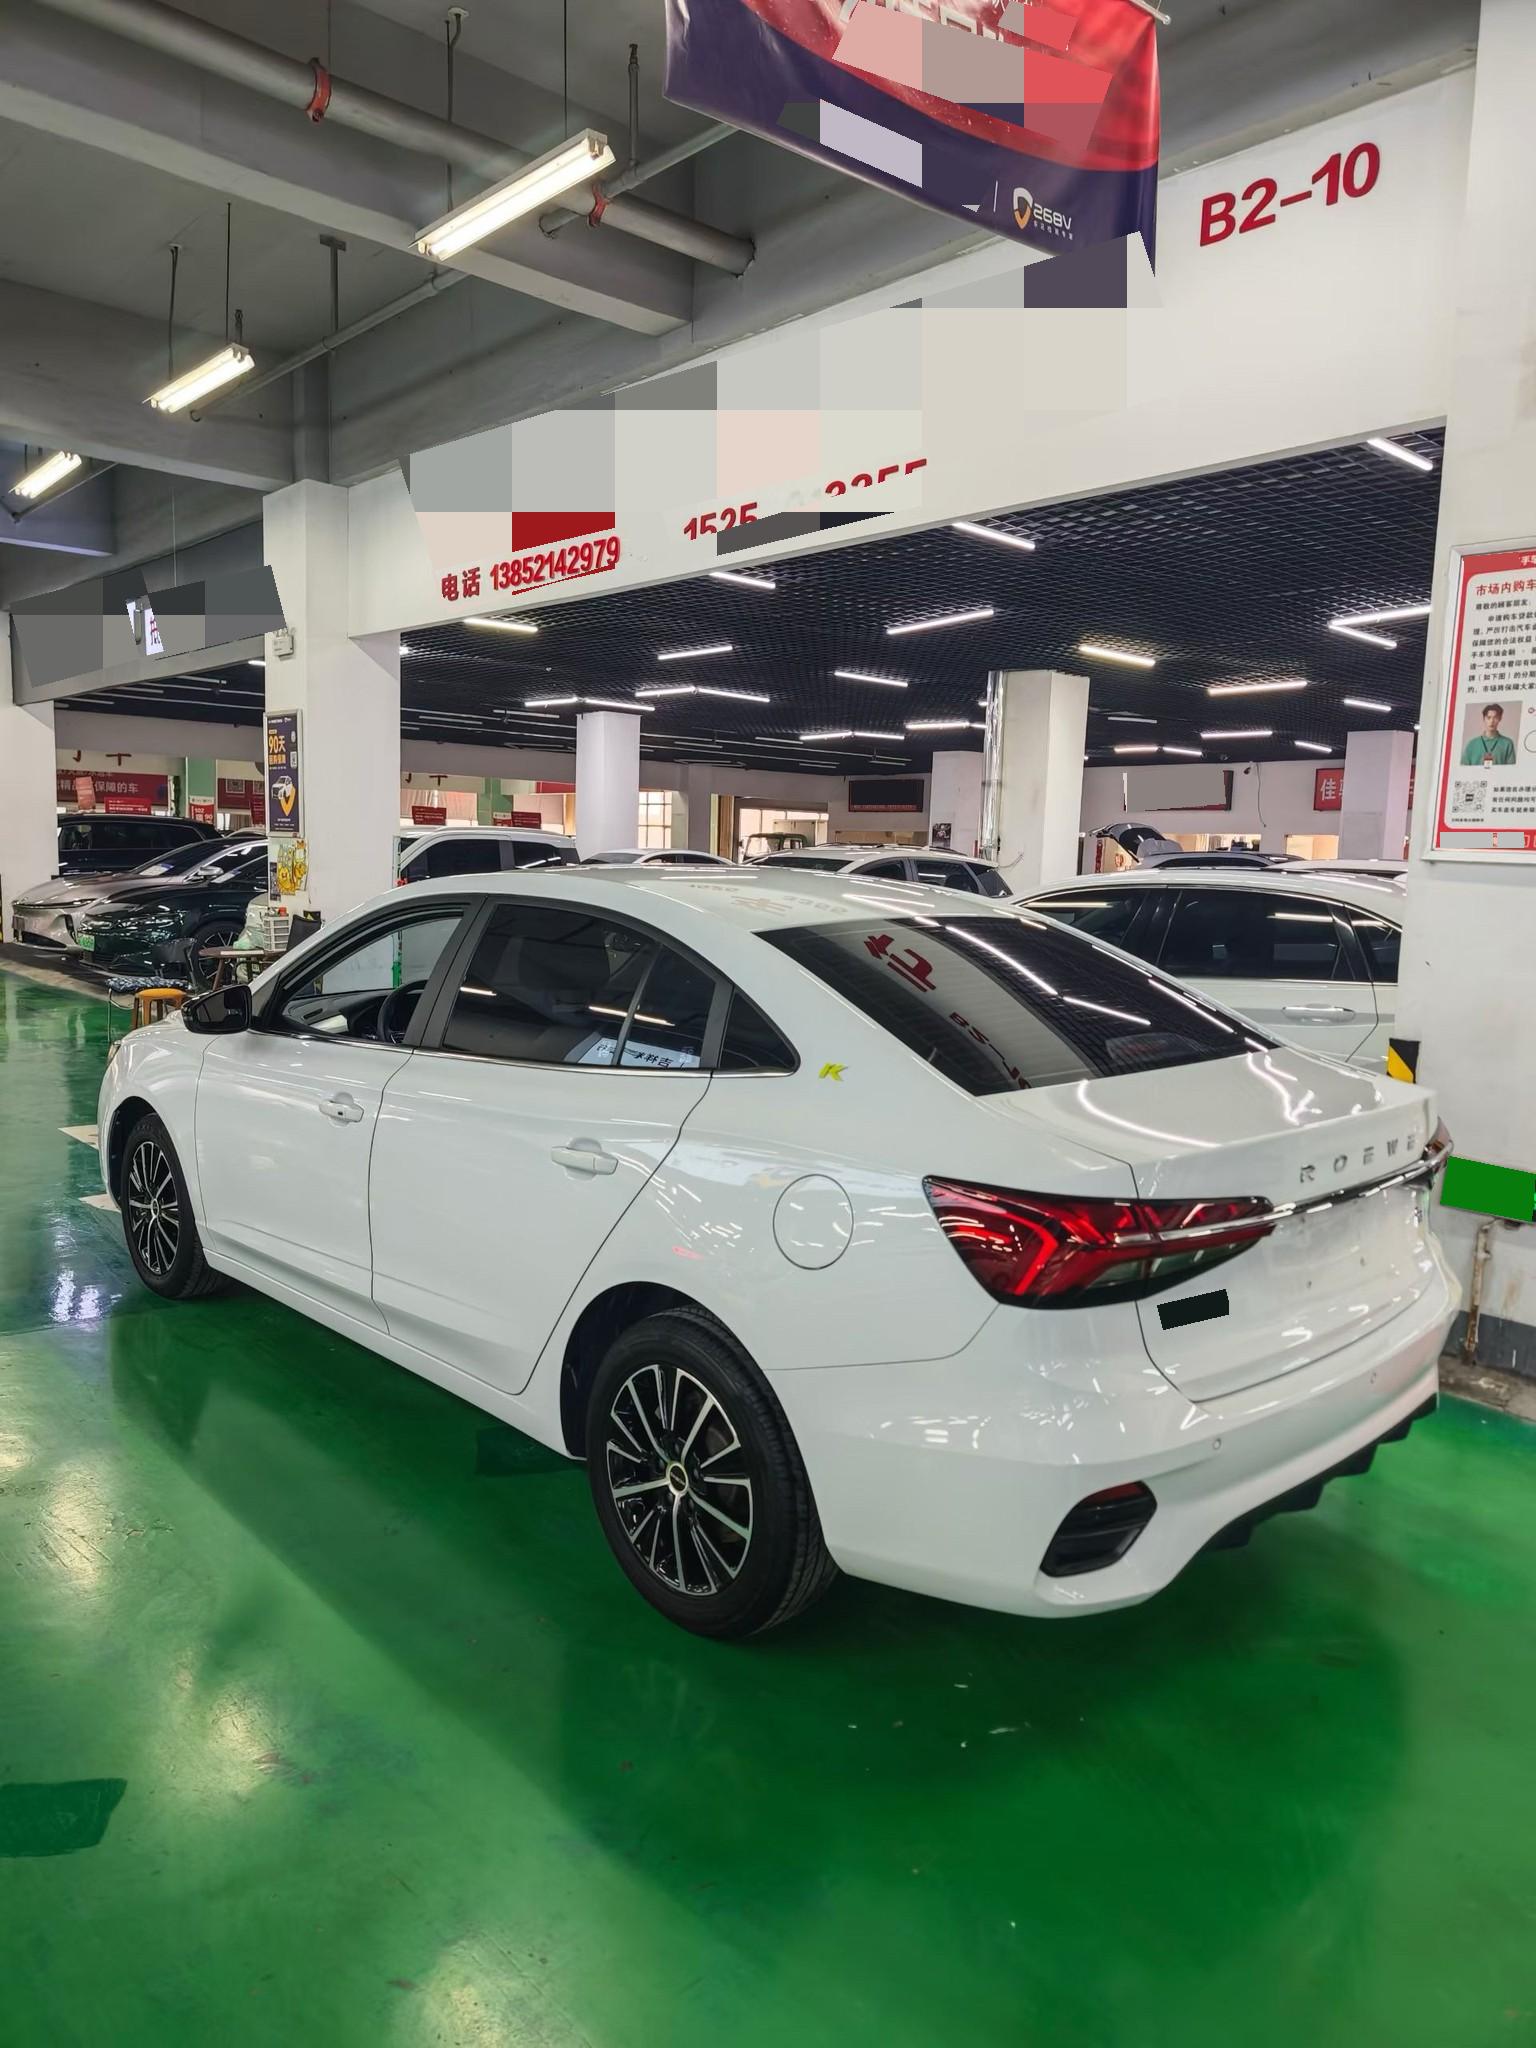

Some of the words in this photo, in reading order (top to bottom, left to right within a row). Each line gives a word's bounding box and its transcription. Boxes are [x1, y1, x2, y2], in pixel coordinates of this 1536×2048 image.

[1033, 202, 1072, 230] 268V
[441, 566, 481, 601] 电话
[490, 536, 621, 591] 13852142979
[1300, 1135, 1416, 1183] ROEWE
